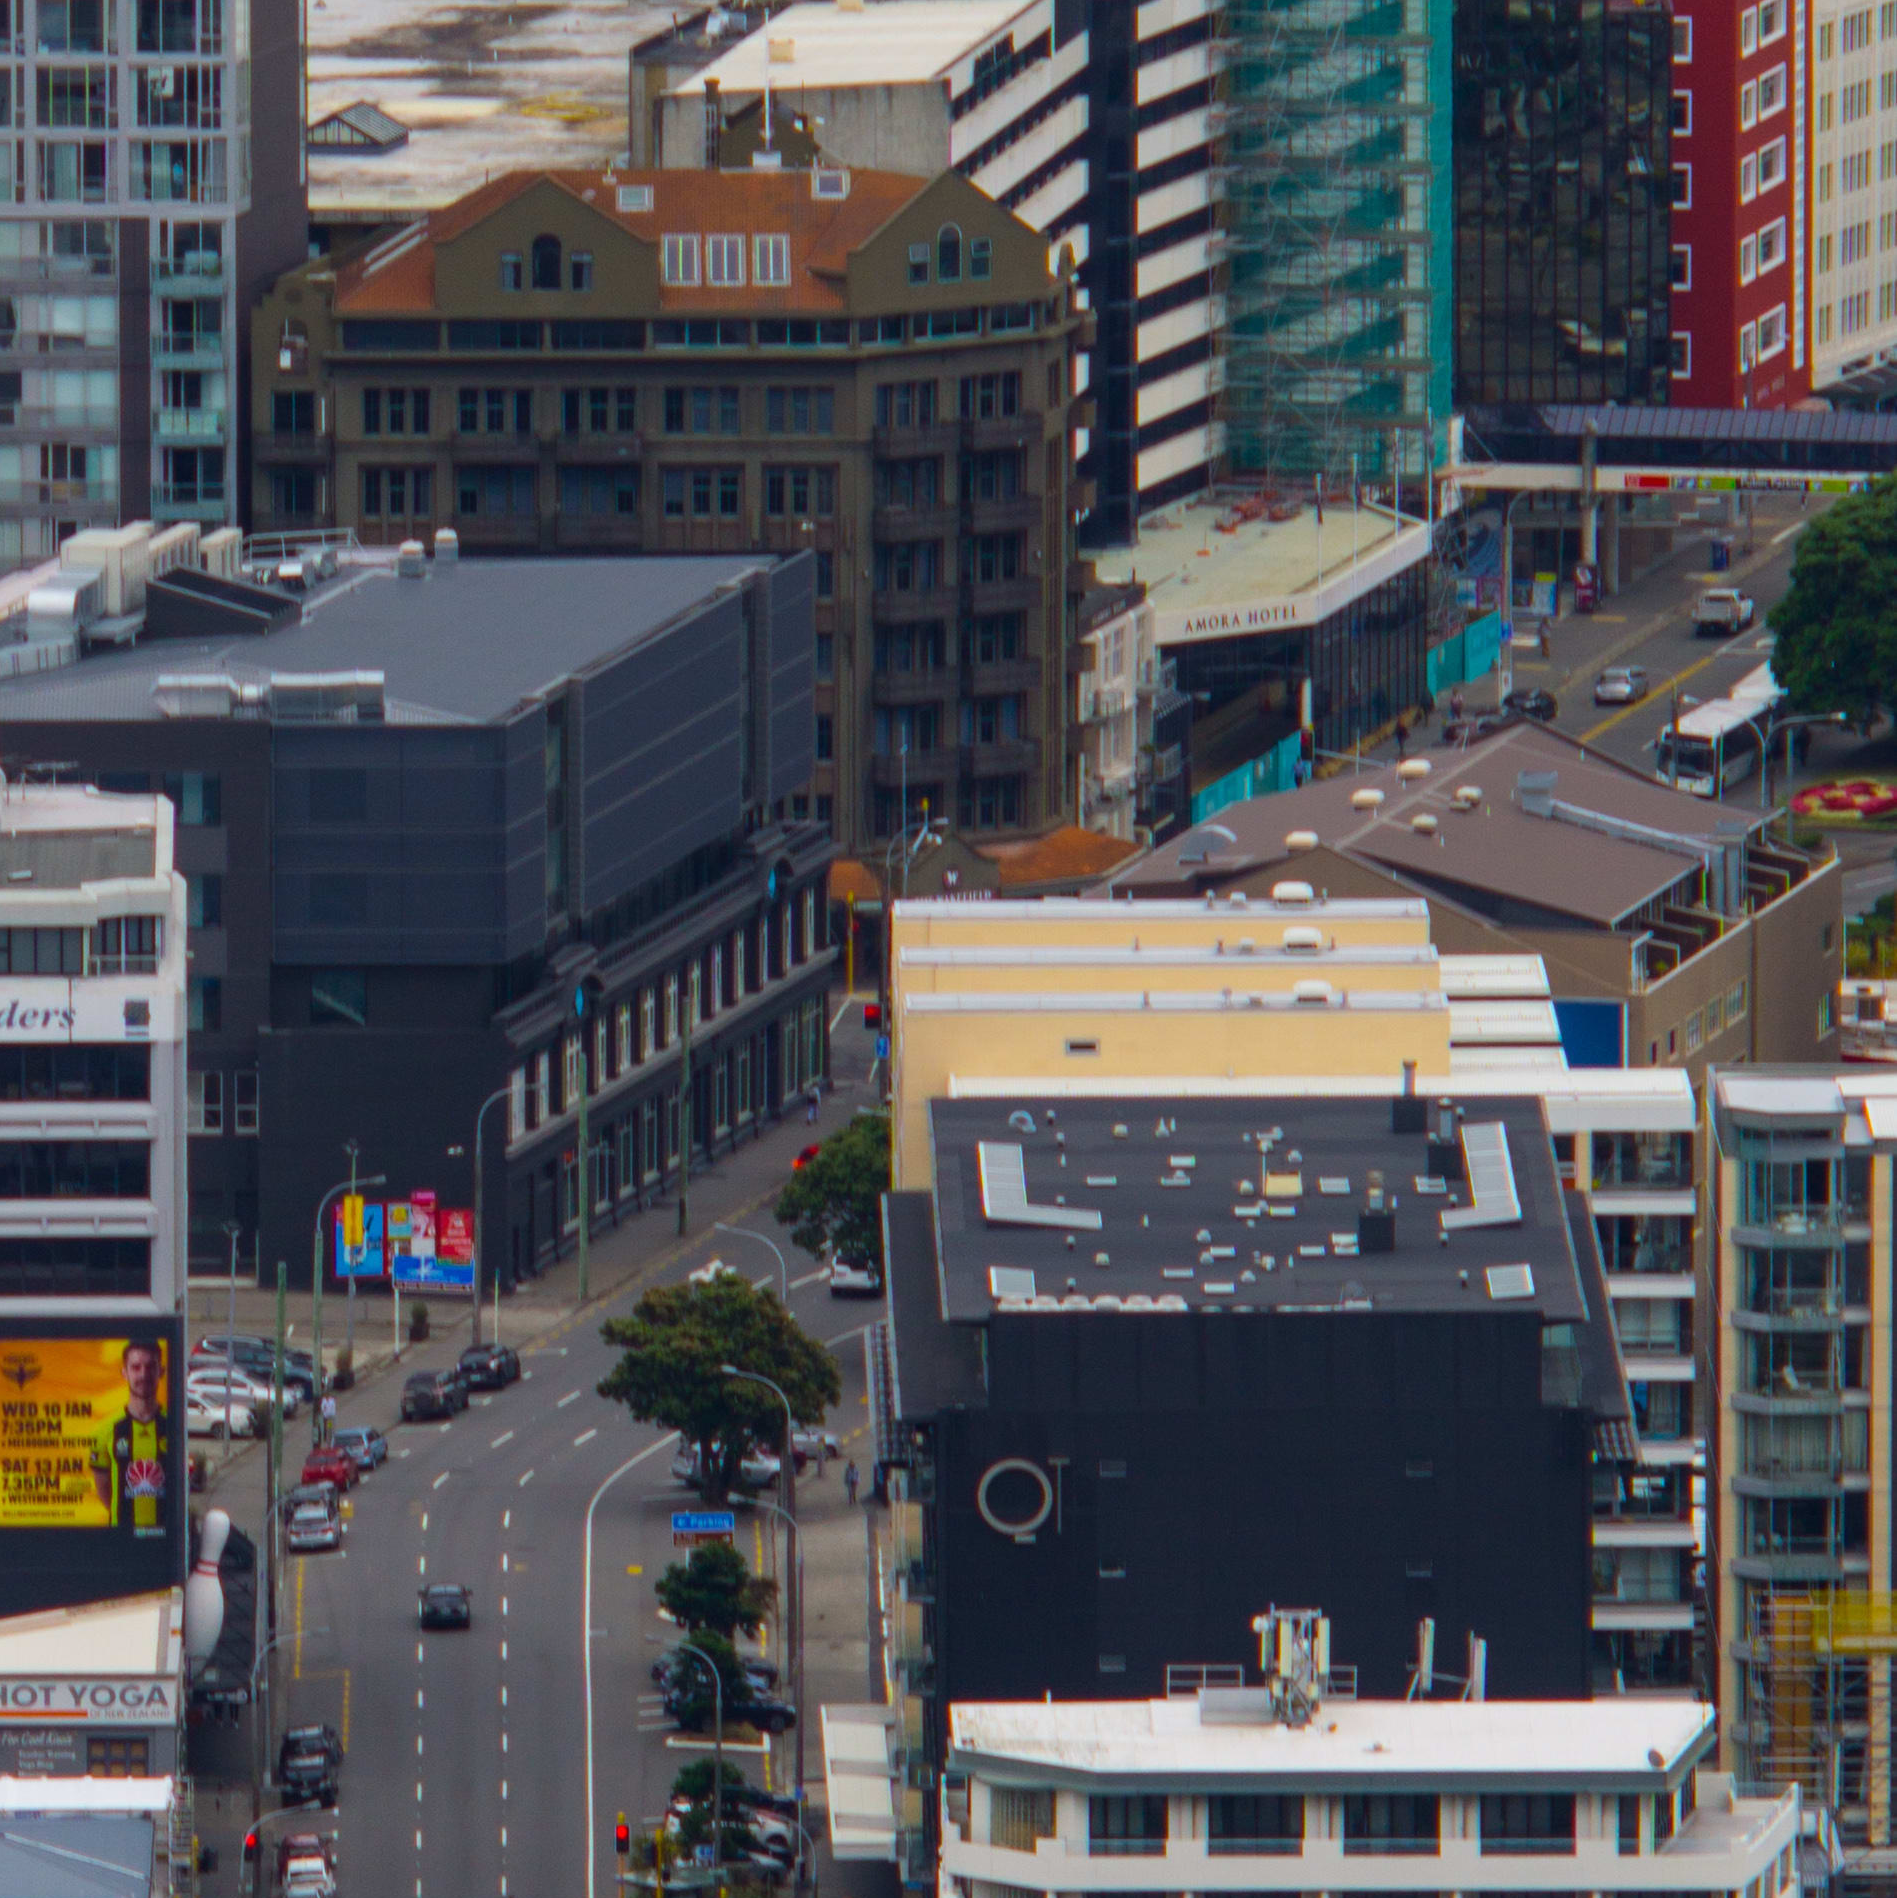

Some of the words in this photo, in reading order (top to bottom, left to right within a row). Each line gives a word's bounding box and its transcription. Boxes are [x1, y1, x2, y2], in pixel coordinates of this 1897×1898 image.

[1184, 612, 1241, 633] AMORA
[1247, 603, 1298, 624] HOTEL
[1, 1402, 38, 1418] WED
[43, 1402, 62, 1418] 10
[65, 1402, 93, 1418] JAN
[1, 1458, 29, 1473] SAT
[35, 1458, 54, 1473] 13
[56, 1458, 83, 1473] JAN
[68, 1684, 169, 1708] YOGA
